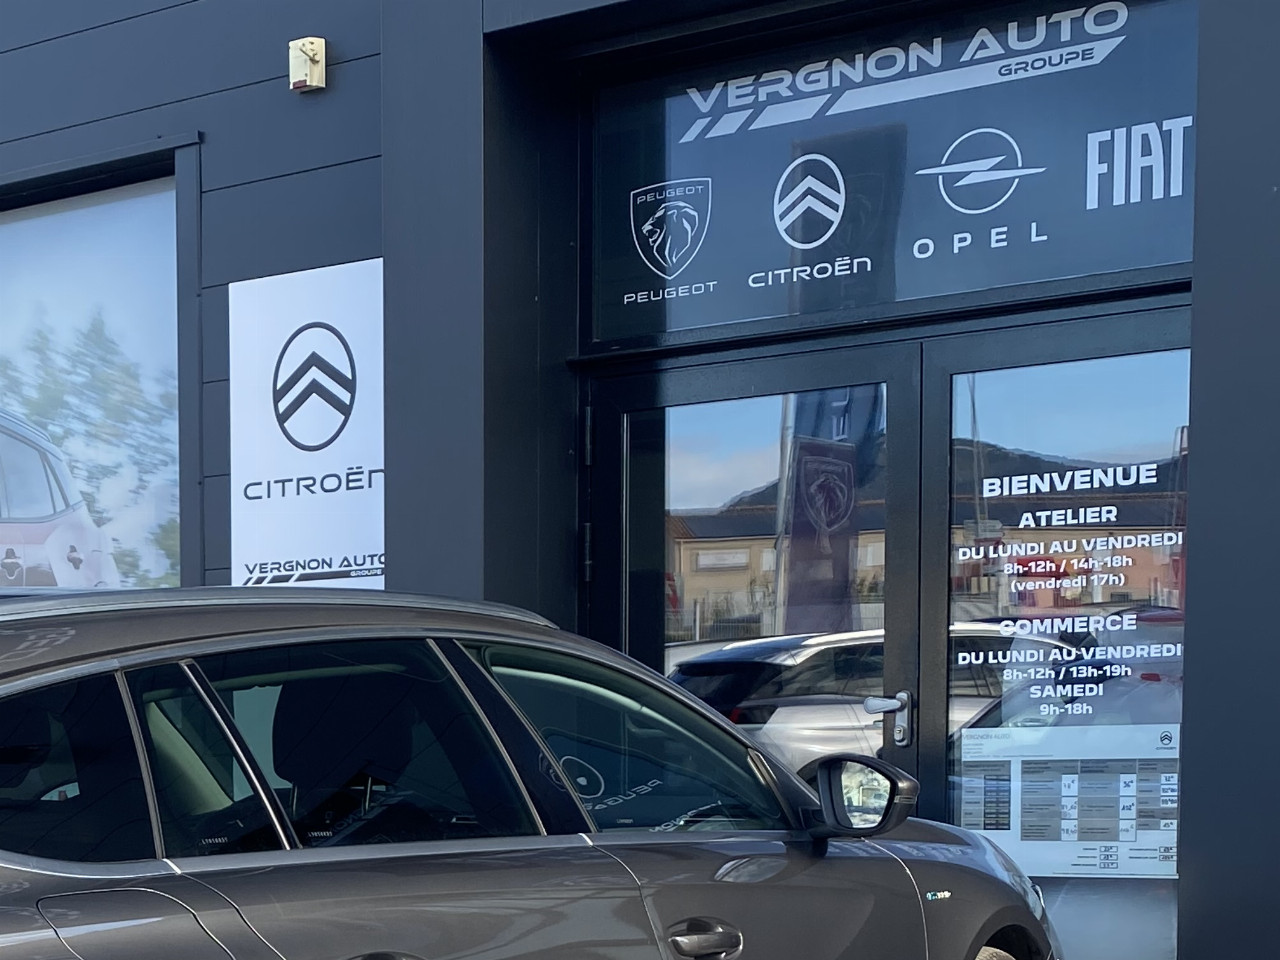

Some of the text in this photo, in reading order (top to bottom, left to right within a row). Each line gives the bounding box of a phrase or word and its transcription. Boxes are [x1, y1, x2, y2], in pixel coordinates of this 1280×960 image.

[686, 1, 1129, 115] VERGNON AUTO
[997, 45, 1095, 78] GROUPE
[1086, 115, 1194, 210] FIAT
[636, 185, 705, 204] PEUGEOT
[913, 222, 1048, 260] OPEL
[624, 281, 718, 304] PEUGEOT
[982, 463, 1158, 498] BIENVENUE
[1018, 505, 1118, 529] ATELIER
[958, 531, 1184, 560] DU LUNDI AU VENDREDI
[244, 557, 332, 575] VERGNON
[1003, 555, 1133, 575] 8h-12h / 14h-18h
[1010, 573, 1125, 594] (vendredi 17h)
[1000, 614, 1137, 635] COMMERCE
[958, 643, 1182, 665] DU LUNDI AU VENDREDI
[1003, 663, 1132, 680] 8h-12h / 13h-19h
[1029, 684, 1104, 699] SAMEDI
[1039, 703, 1093, 716] 9h-18h
